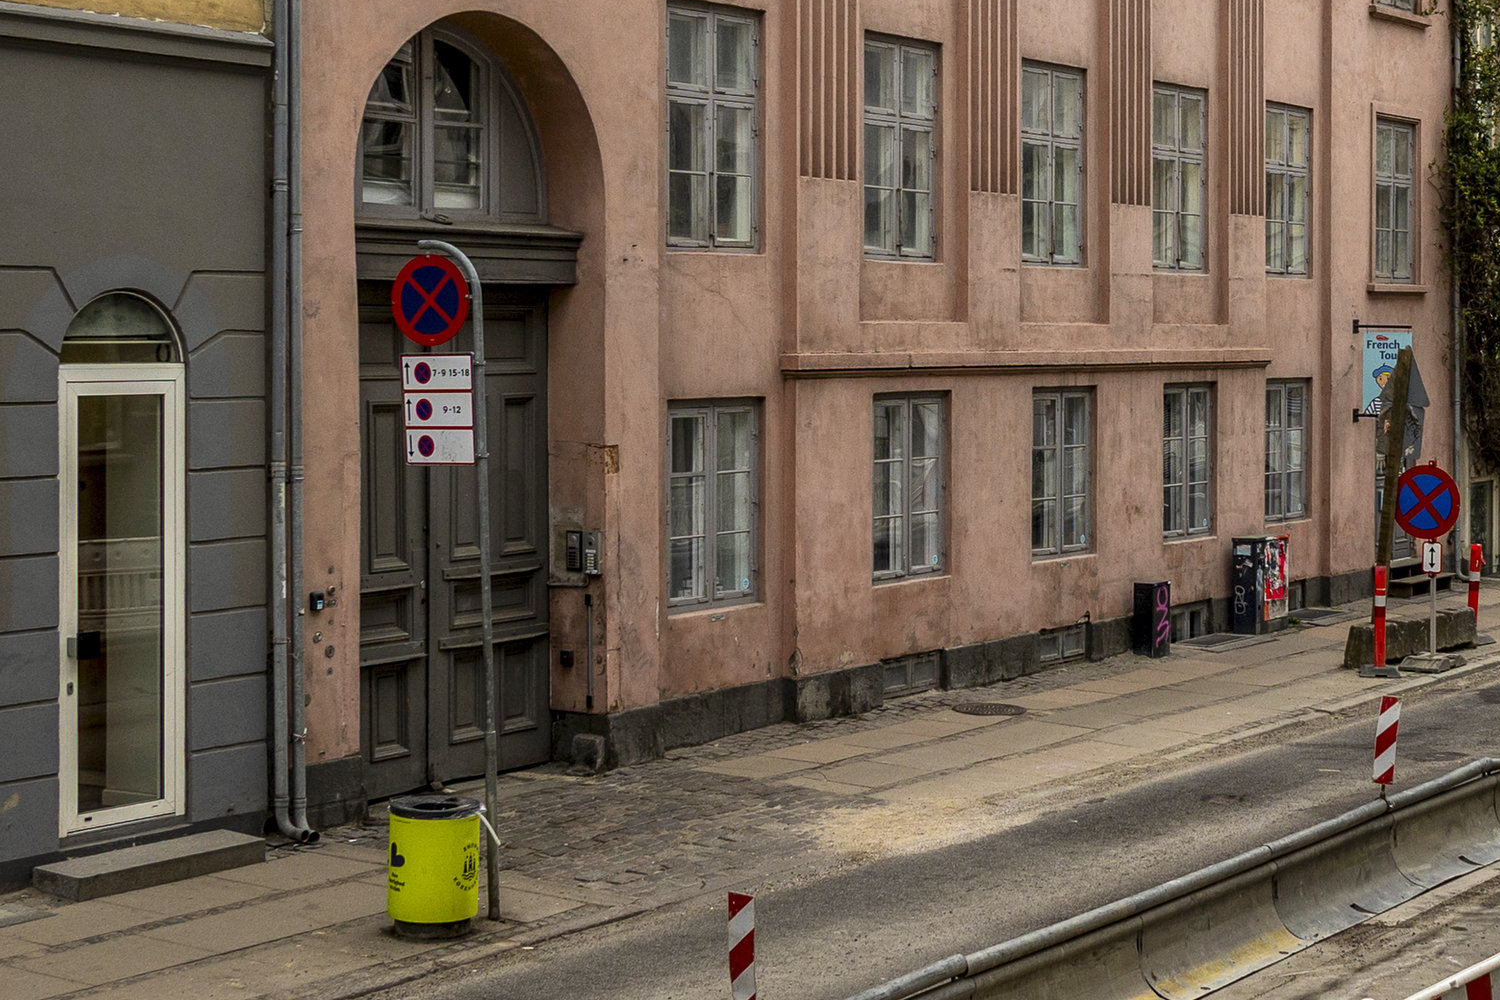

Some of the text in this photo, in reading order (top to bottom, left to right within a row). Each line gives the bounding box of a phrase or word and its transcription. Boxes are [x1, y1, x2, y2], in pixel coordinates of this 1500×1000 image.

[1366, 339, 1400, 349] French
[1380, 350, 1397, 360] Tou
[432, 369, 470, 377] 7-9 15-18
[442, 406, 462, 414] 9-12
